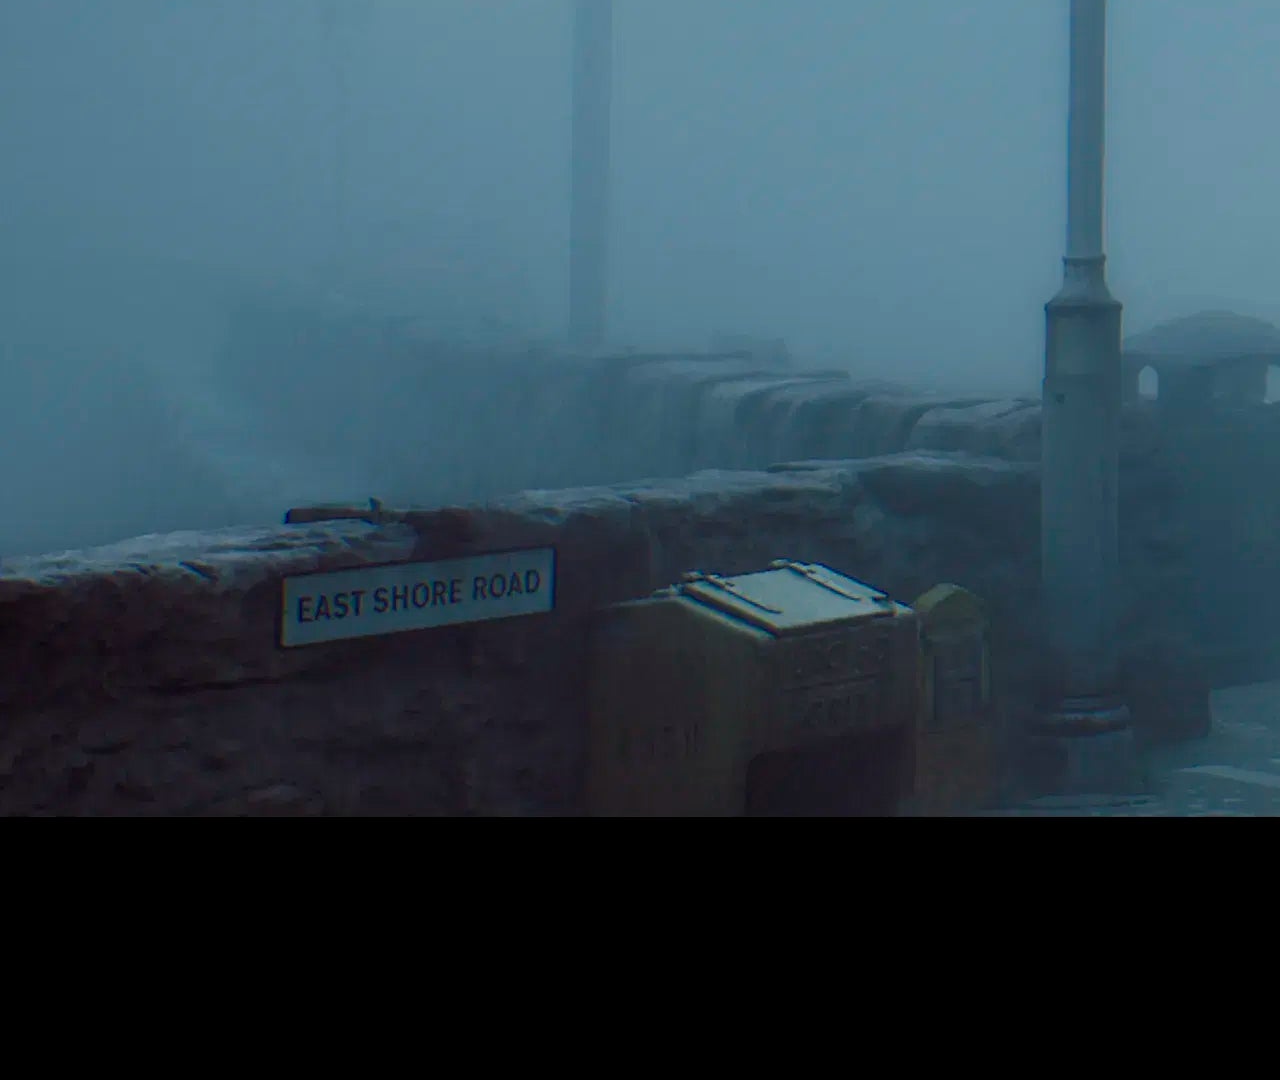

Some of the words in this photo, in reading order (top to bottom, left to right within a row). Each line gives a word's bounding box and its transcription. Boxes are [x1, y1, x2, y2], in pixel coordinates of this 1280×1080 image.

[297, 590, 365, 623] EAST
[373, 579, 463, 613] SHORE
[472, 570, 541, 601] ROAD
